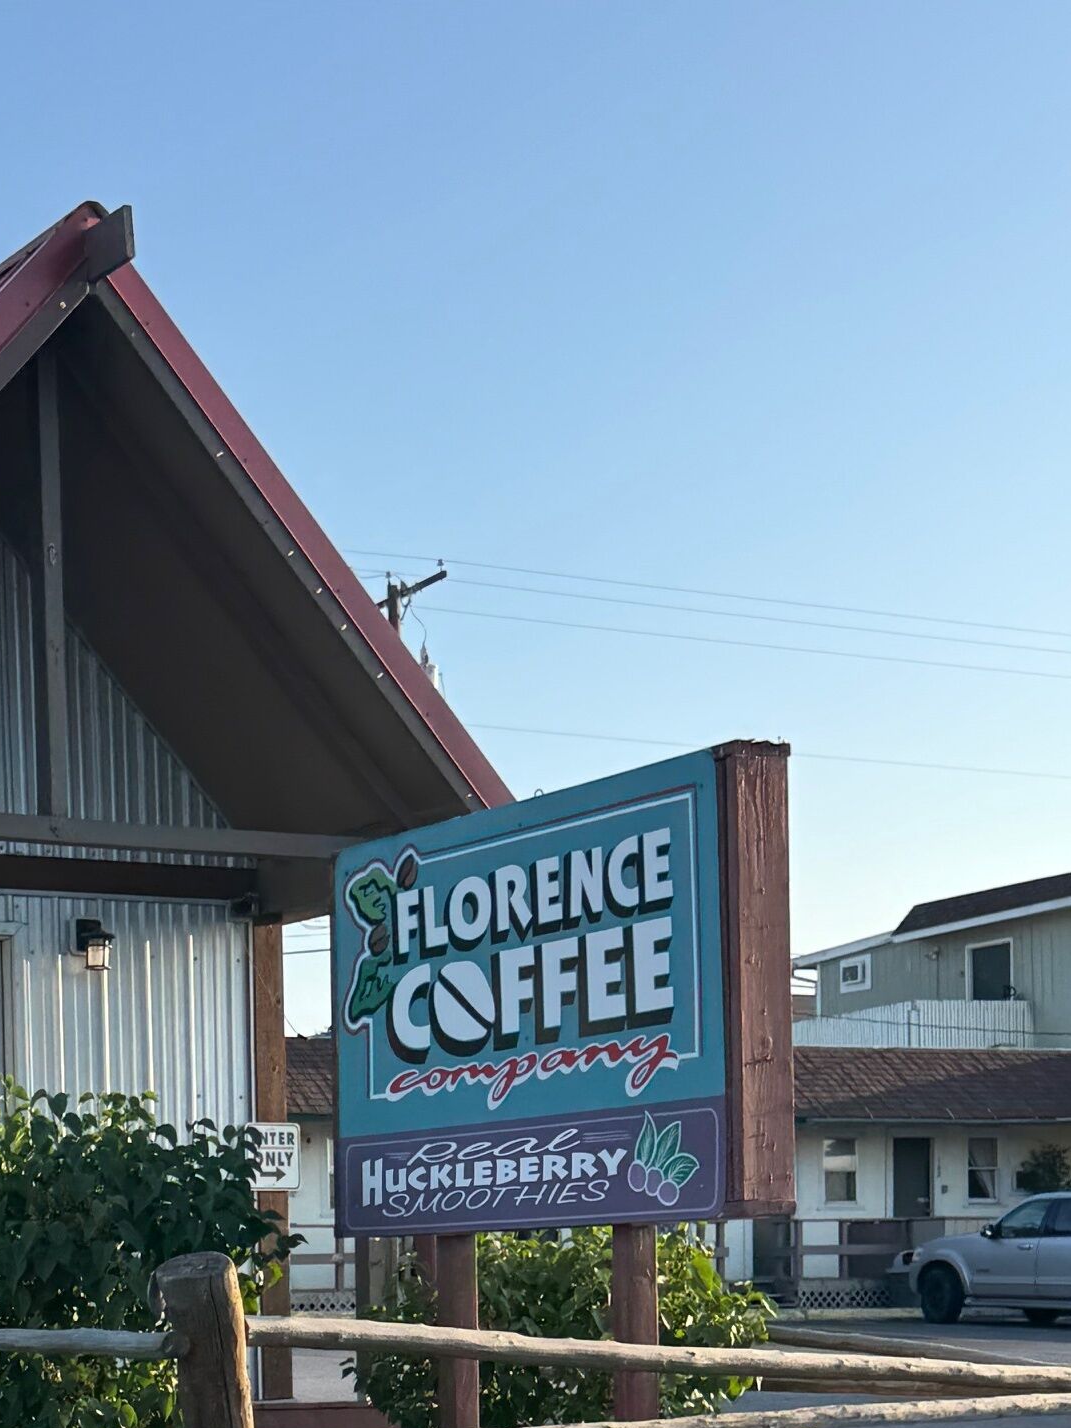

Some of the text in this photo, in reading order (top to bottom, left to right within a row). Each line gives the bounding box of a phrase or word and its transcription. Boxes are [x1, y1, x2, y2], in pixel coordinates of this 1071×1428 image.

[395, 827, 674, 957] FLORENCE
[391, 916, 675, 1050] COFFEE
[387, 1032, 680, 1110] company
[259, 1132, 295, 1145] NTER
[407, 1128, 581, 1167] Real
[381, 1179, 611, 1218] SMOOTHIES
